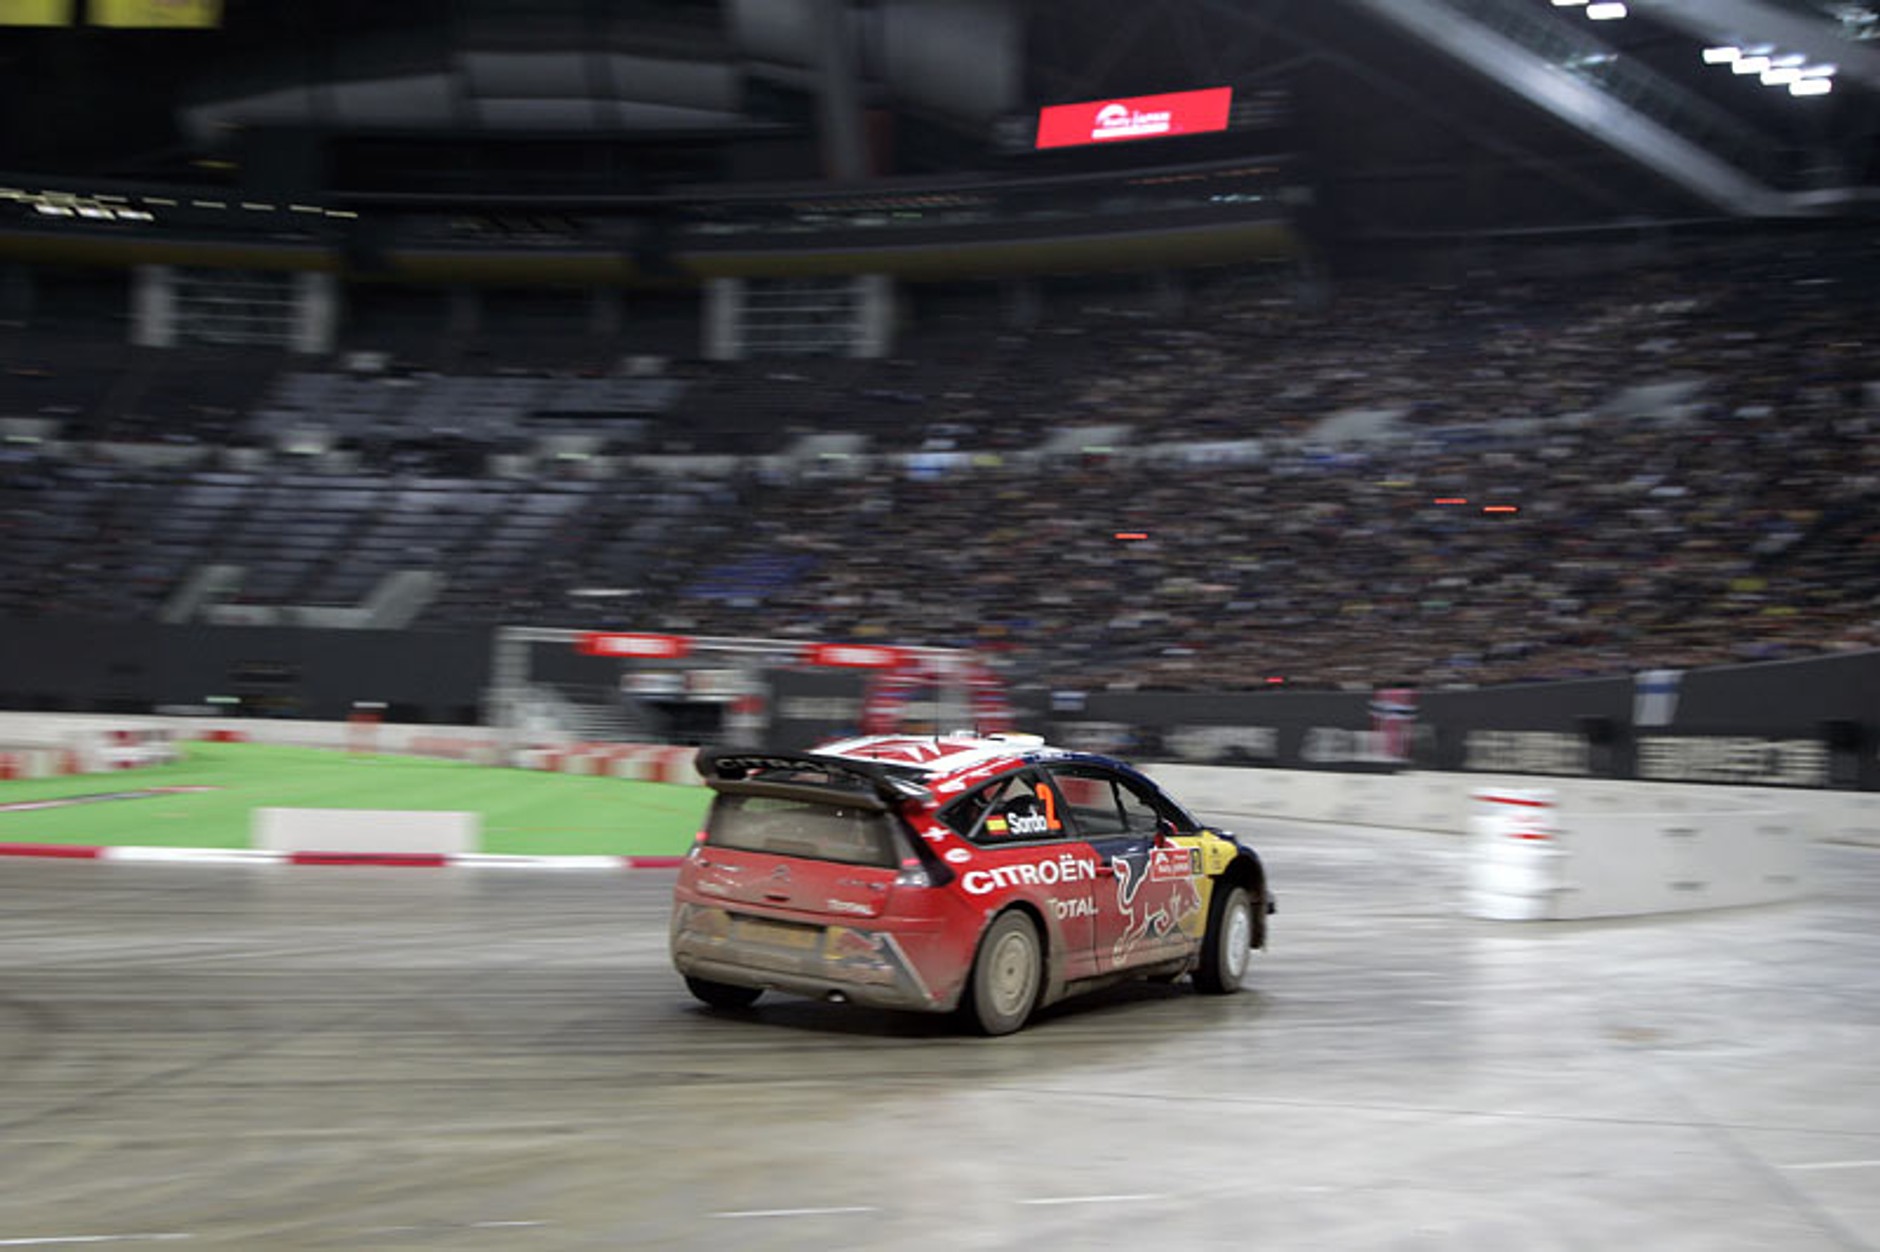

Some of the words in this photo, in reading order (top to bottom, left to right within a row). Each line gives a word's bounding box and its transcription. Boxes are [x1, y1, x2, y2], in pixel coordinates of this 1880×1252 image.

[1035, 782, 1062, 830] 2
[961, 853, 1097, 895] CITROËN
[1045, 896, 1099, 920] TOTAL
